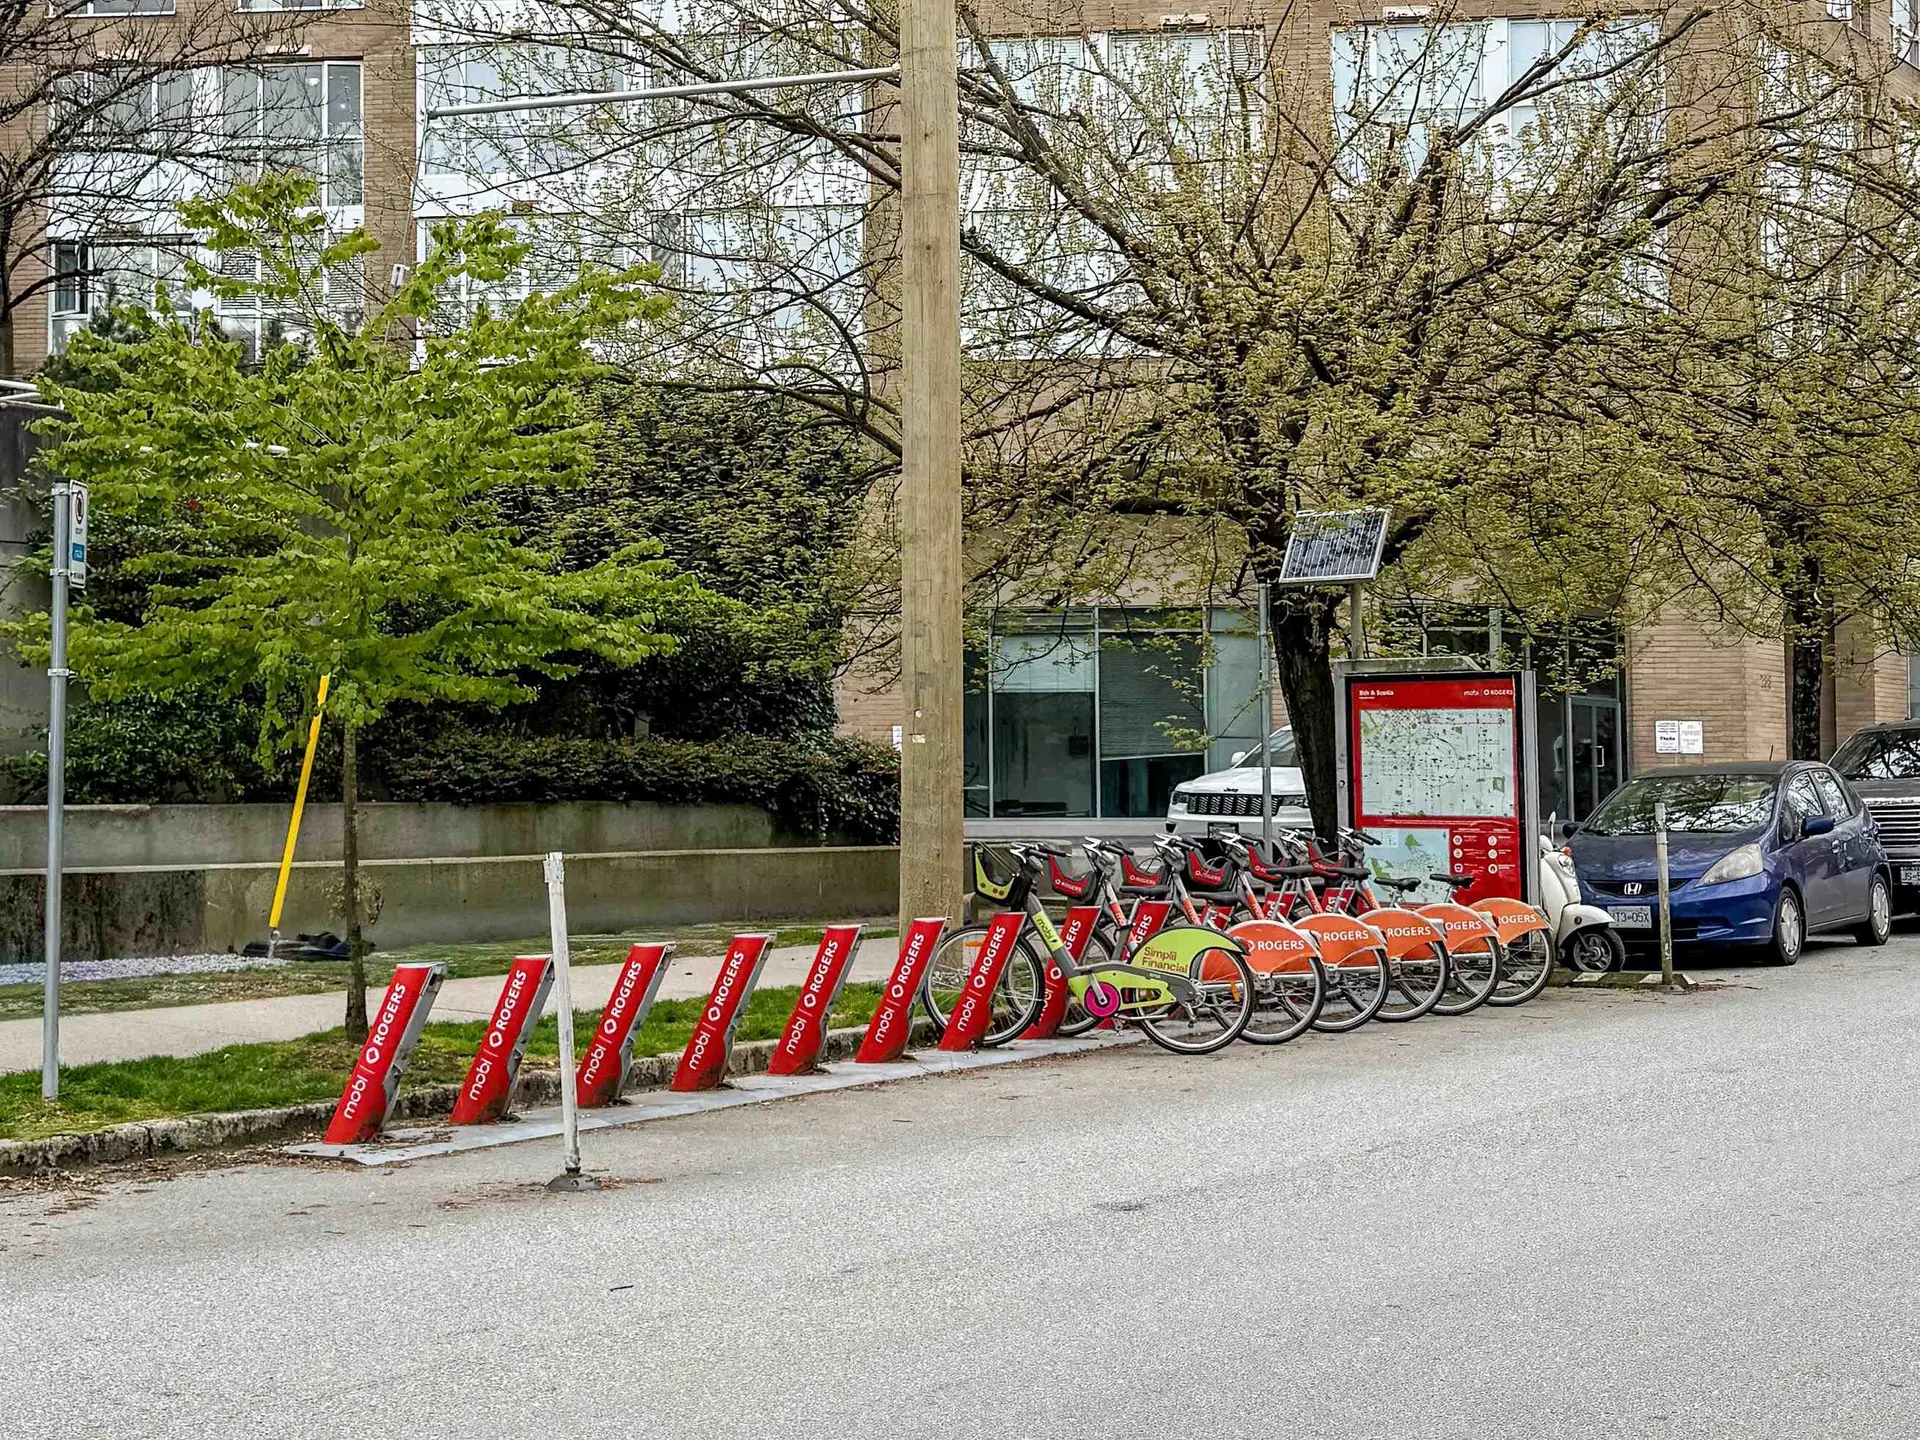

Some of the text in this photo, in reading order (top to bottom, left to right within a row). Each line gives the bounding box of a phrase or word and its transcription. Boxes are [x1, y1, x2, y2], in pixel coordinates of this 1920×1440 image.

[1036, 918, 1058, 943] mobi
[1064, 919, 1082, 951] GERS
[1135, 914, 1153, 944] GERS
[1323, 929, 1369, 942] ROGERS
[1386, 926, 1431, 938] ROGERS
[1444, 920, 1482, 931] OGERS
[1257, 939, 1305, 951] ROGERS
[957, 926, 1006, 1032] mobi ROGERS
[1142, 956, 1188, 973] Financial
[786, 939, 838, 1055] mobi ROGERS
[875, 933, 924, 1043] mobi ROGERS
[583, 961, 642, 1085] mobi ROGERS
[688, 951, 744, 1070] mobi ROGERS
[343, 983, 406, 1119] mobi ROGERS
[469, 969, 527, 1101] mobi ROGERS
